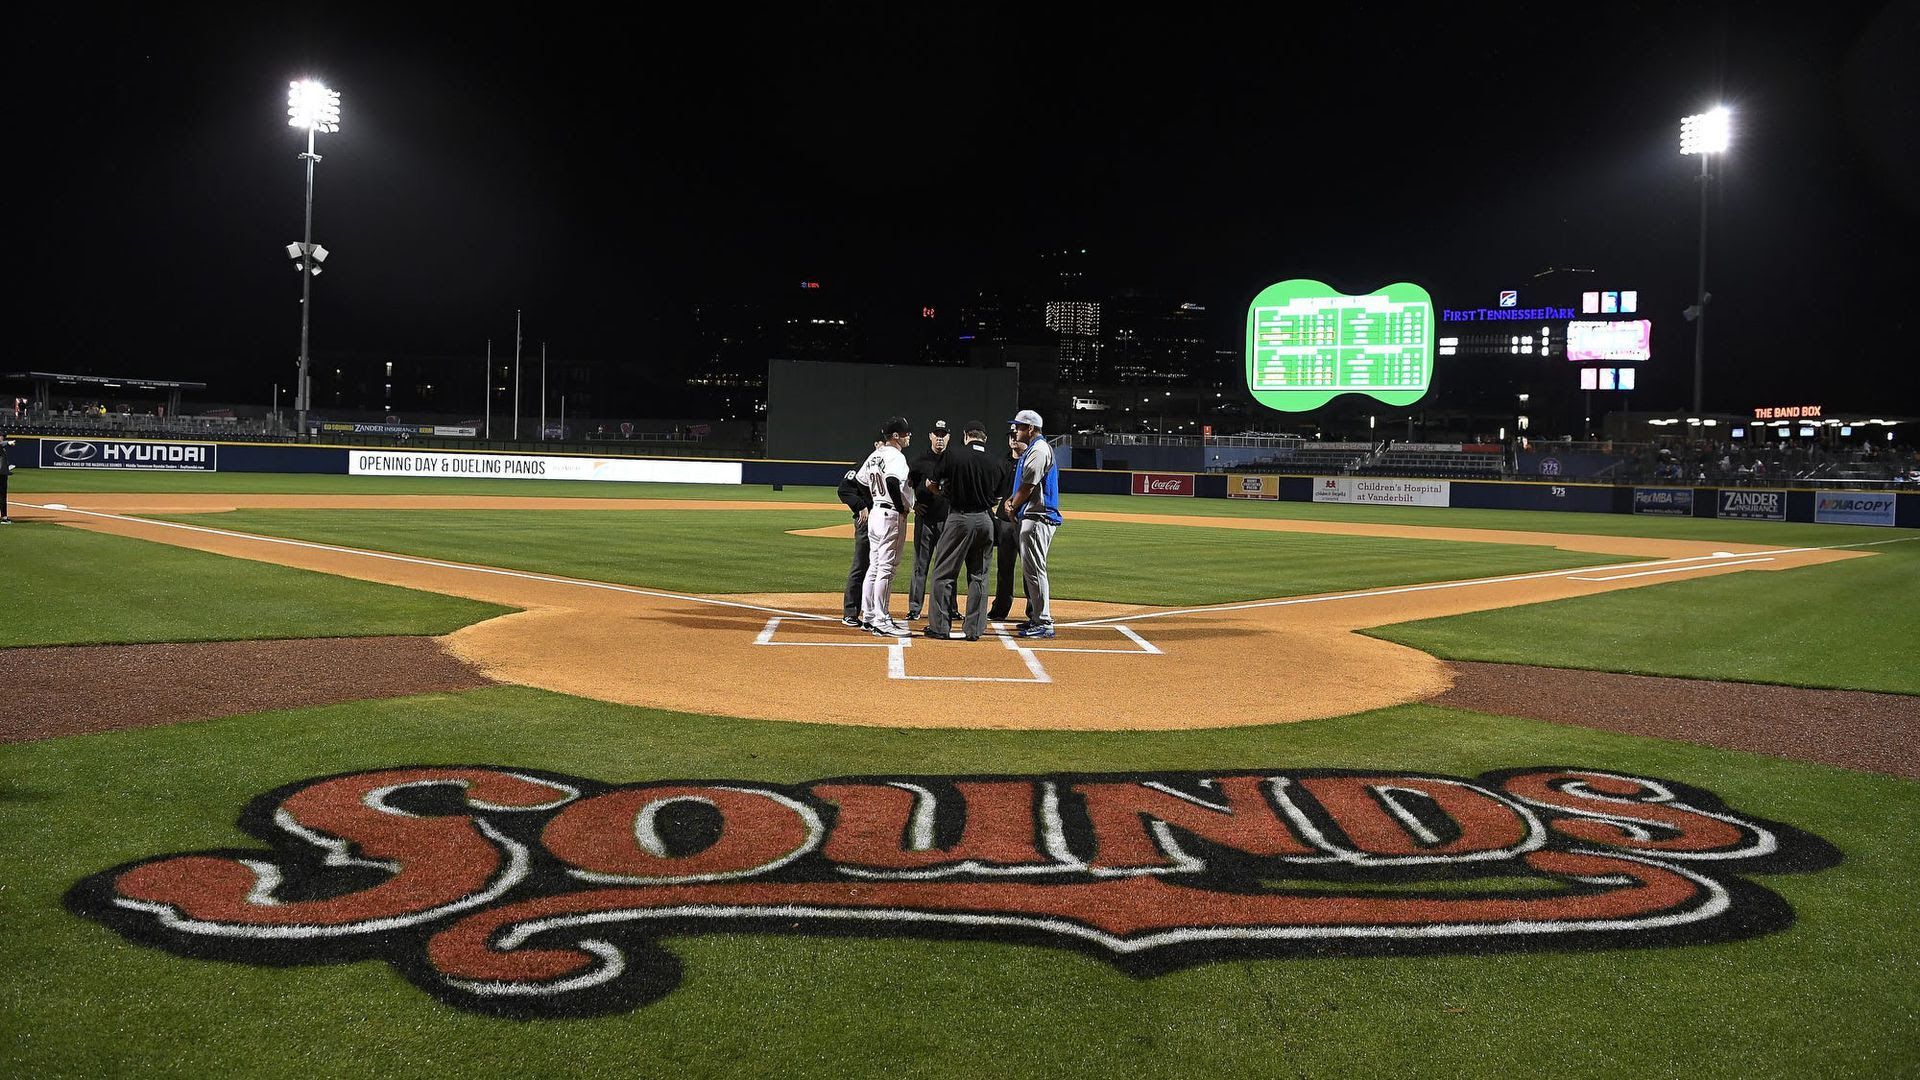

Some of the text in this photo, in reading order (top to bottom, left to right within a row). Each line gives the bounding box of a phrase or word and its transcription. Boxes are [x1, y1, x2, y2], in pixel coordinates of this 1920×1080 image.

[1443, 306, 1575, 321] FIRST TENNESSEE PARK
[1754, 405, 1822, 418] THE BAND BOX
[354, 424, 384, 432] ZANDER
[103, 444, 205, 462] HYUNDAI
[359, 455, 411, 471] OPENING
[415, 457, 438, 472] DAY
[441, 458, 449, 472] &
[452, 458, 500, 474] DUELING
[504, 460, 546, 475] PIANOS
[870, 473, 886, 497] 20
[1357, 482, 1442, 494] Children's Hospital
[1552, 486, 1566, 497] 375
[1368, 493, 1413, 502] Vanderbilt
[1724, 491, 1778, 511] ZANDER
[1736, 504, 1777, 513] INSURANCE
[106, 764, 1785, 948] SOUNDS
